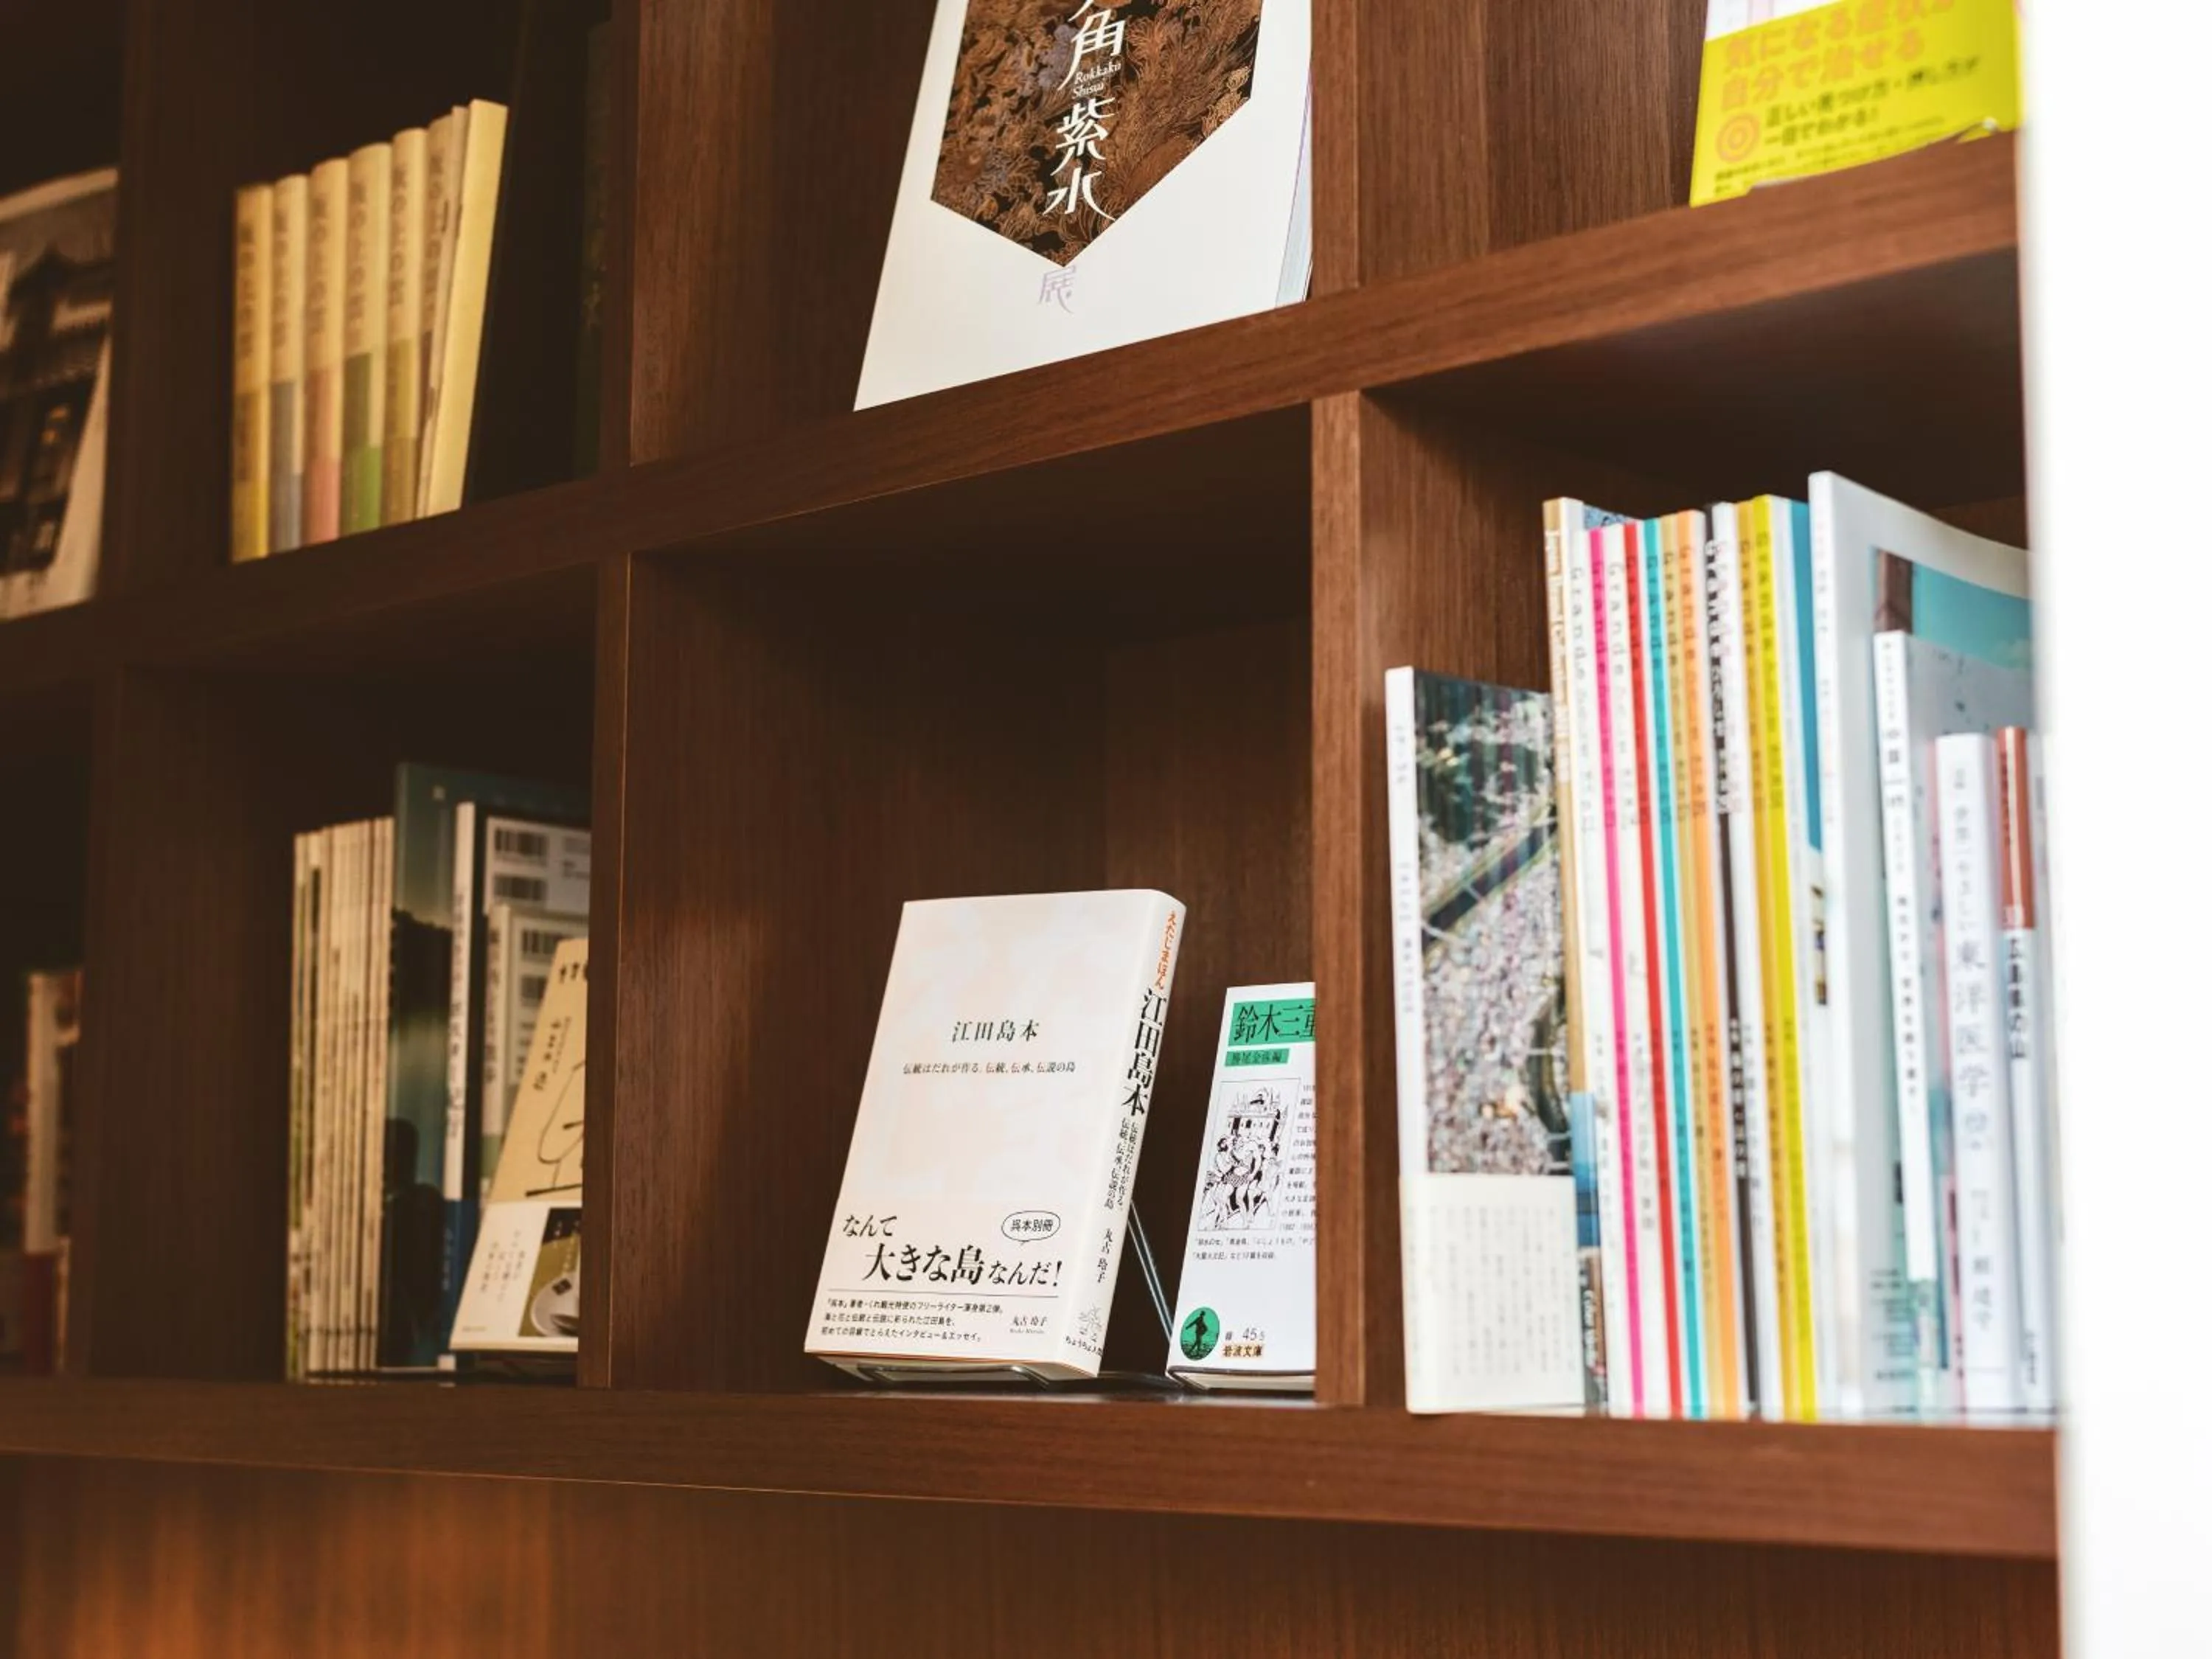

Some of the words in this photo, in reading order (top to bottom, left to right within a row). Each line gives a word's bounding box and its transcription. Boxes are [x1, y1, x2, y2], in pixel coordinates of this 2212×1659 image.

[1037, 264, 1077, 315] 展
[1154, 911, 1177, 990] えたじまほん
[950, 1019, 1040, 1043] 江田島本
[1120, 987, 1168, 1116] 江田島本
[842, 1214, 897, 1237] なんて
[1010, 1219, 1054, 1233] 呉本別冊
[1223, 1345, 1263, 1357] 岩波文庫
